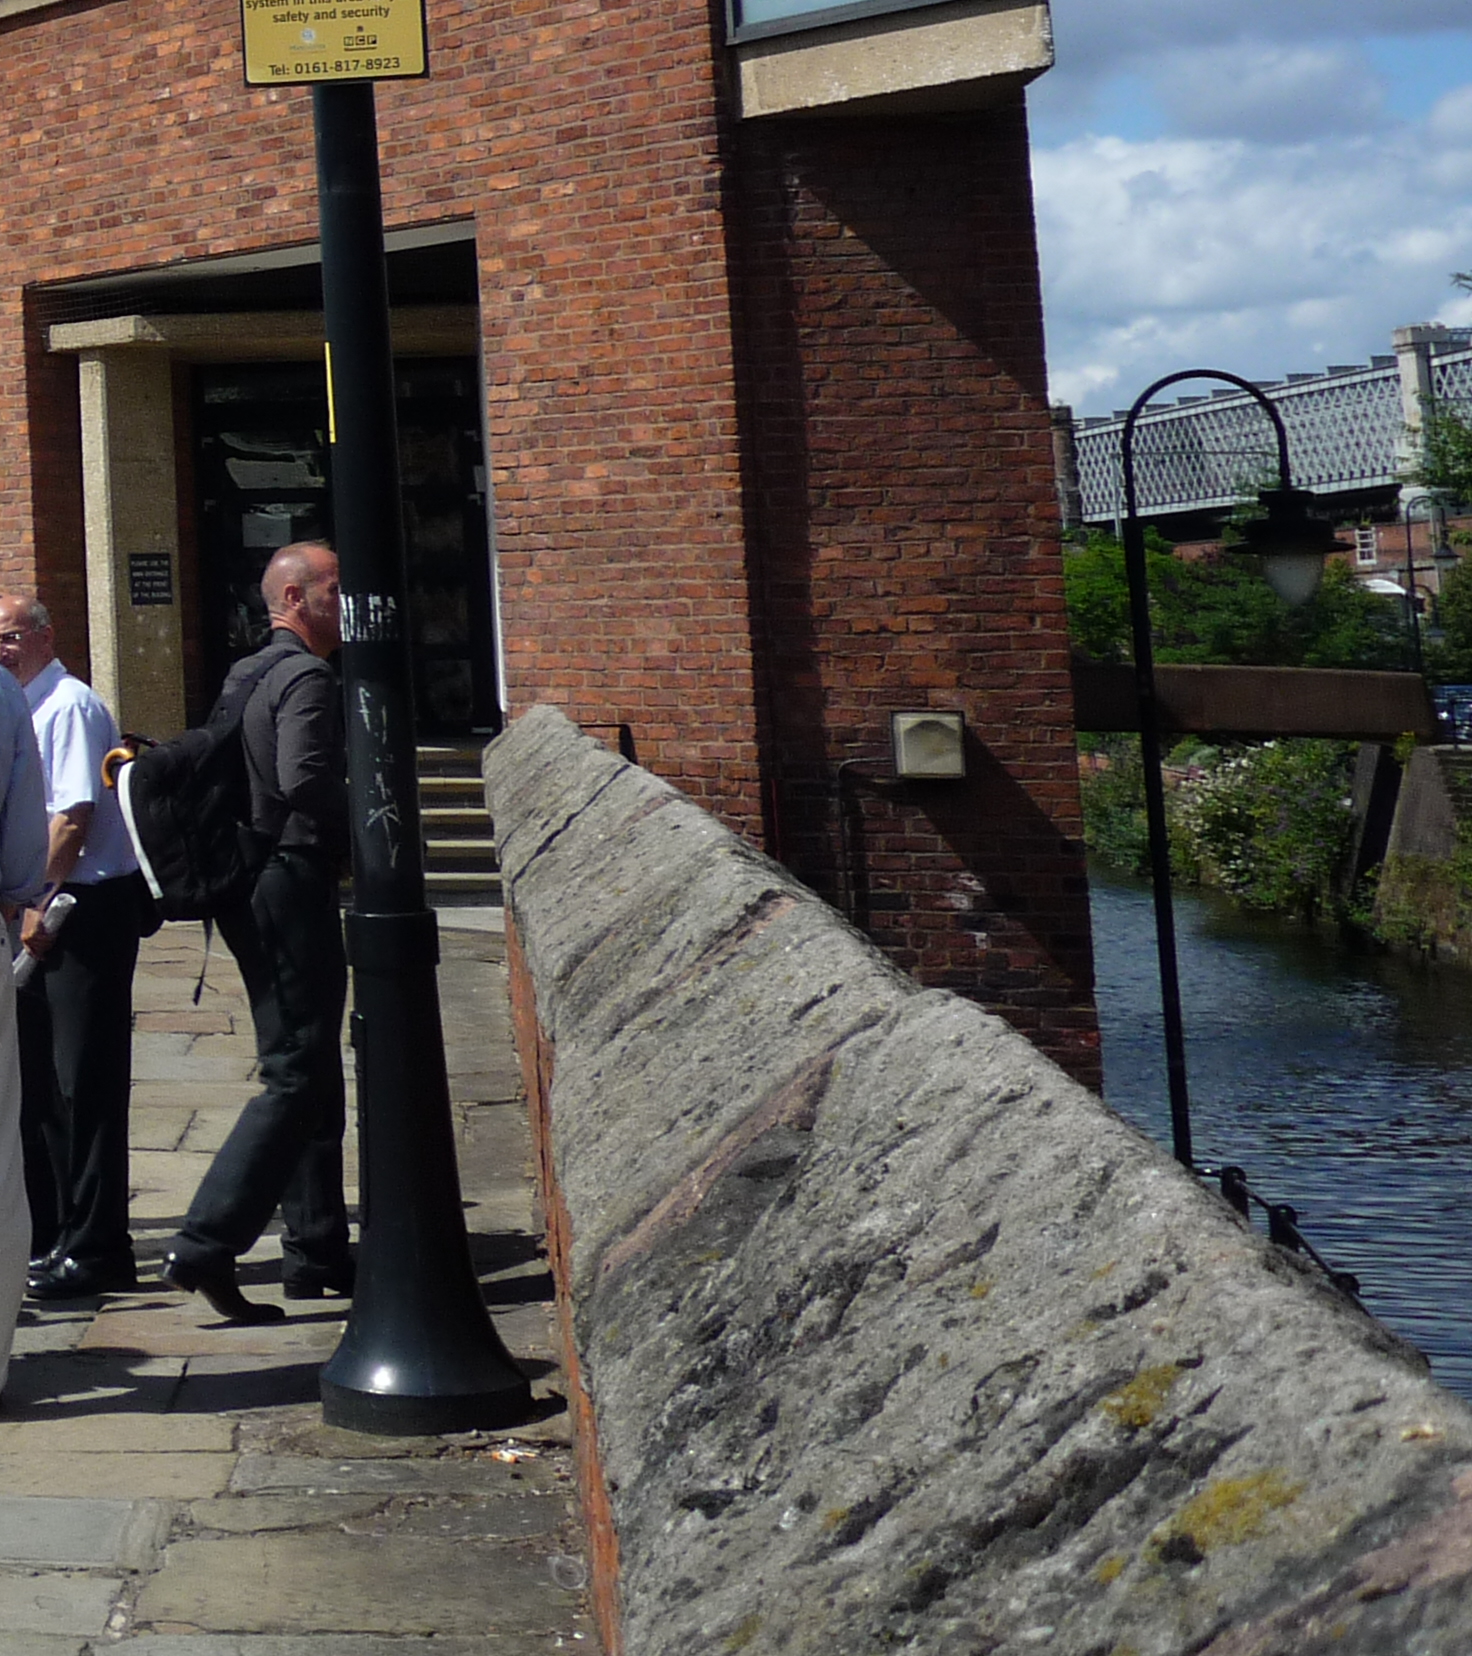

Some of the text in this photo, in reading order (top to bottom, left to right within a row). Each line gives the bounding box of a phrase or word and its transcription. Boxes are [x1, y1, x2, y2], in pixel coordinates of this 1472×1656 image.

[273, 5, 390, 24] safety and security
[268, 57, 401, 76] Tel: 0161-817-8923
